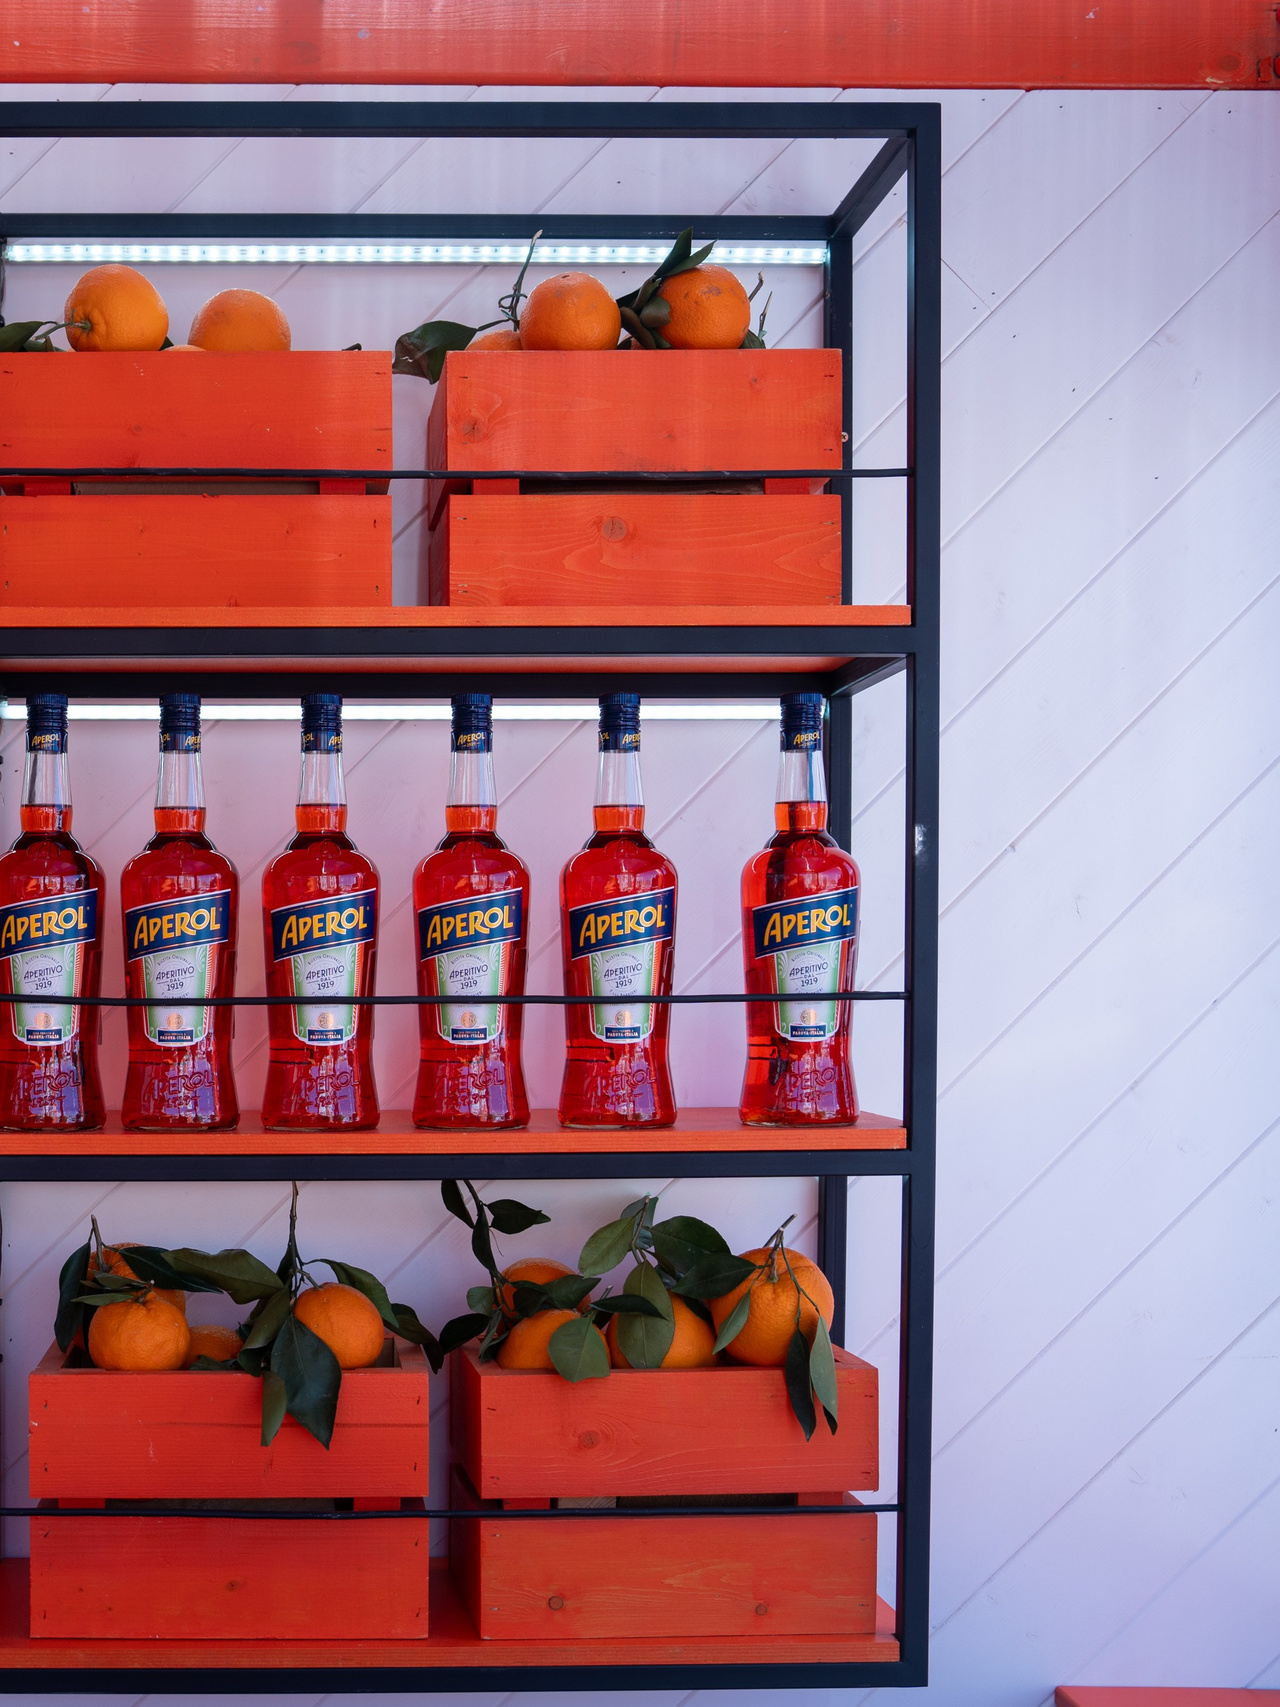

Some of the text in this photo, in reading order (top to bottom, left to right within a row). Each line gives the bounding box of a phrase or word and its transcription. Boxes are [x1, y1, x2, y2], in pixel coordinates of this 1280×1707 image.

[33, 734, 60, 746] APEROL
[457, 732, 485, 745] APEROL
[622, 732, 640, 744] APERO
[794, 731, 820, 745] APEROL
[2, 907, 87, 948] APEROL
[134, 908, 220, 948] APEROL
[282, 907, 367, 948] APEROL
[427, 906, 513, 948] APEROL
[580, 905, 665, 946] APEROL
[764, 904, 850, 946] APEROL
[25, 965, 63, 980] APERITIVO
[156, 966, 195, 981] APERITIVO
[307, 965, 345, 981] APERITIVO
[450, 964, 489, 980] APERITIVO
[605, 963, 643, 978] APERITIVO
[790, 962, 829, 977] APERITIVO
[35, 981, 52, 990] 1919
[166, 982, 183, 991] 1919
[317, 981, 334, 990] 1919
[460, 980, 477, 989] 1919
[615, 979, 632, 988] 1919
[800, 978, 817, 987] 1919
